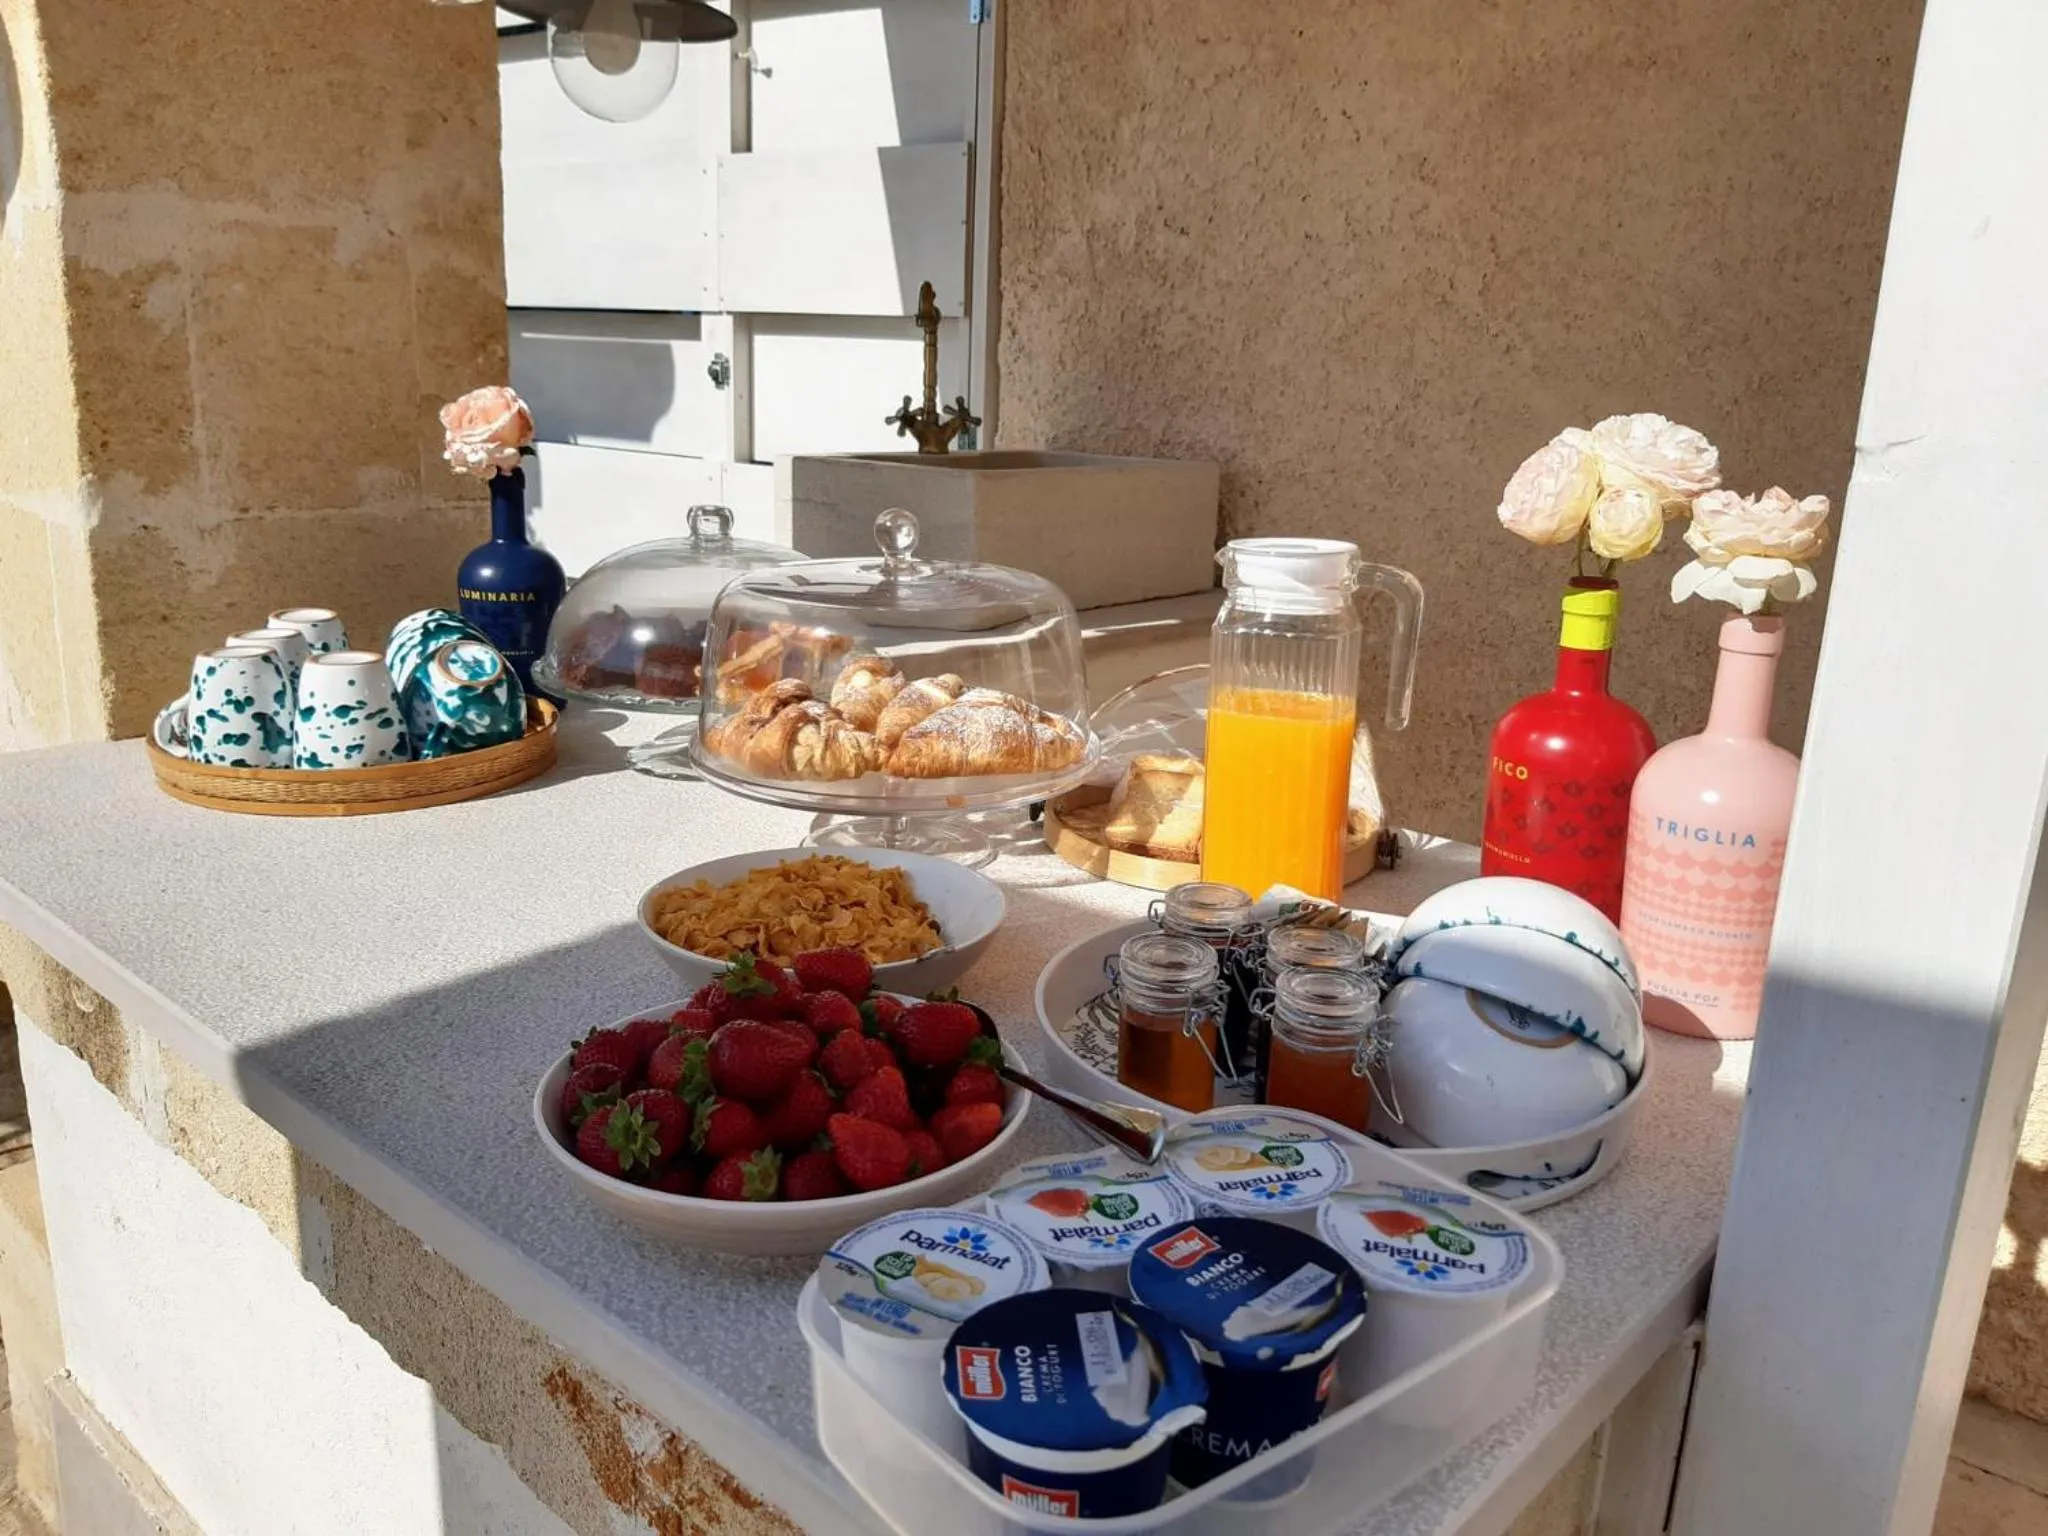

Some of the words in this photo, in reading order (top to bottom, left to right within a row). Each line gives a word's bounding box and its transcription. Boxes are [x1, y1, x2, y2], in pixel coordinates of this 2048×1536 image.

[460, 588, 536, 602] LUMINARIA
[1655, 816, 1757, 848] TRIGLIA
[1216, 1167, 1323, 1193] parmalat
[1047, 1212, 1163, 1242] parmalat
[899, 1228, 1013, 1270] parmalat
[1361, 1238, 1486, 1275] parmalat
[1185, 1252, 1245, 1287] BIANCO
[967, 1354, 993, 1395] müller
[1014, 1345, 1038, 1403] BIANCO
[1037, 1356, 1053, 1394] CREMA
[1180, 1422, 1272, 1459] REMA
